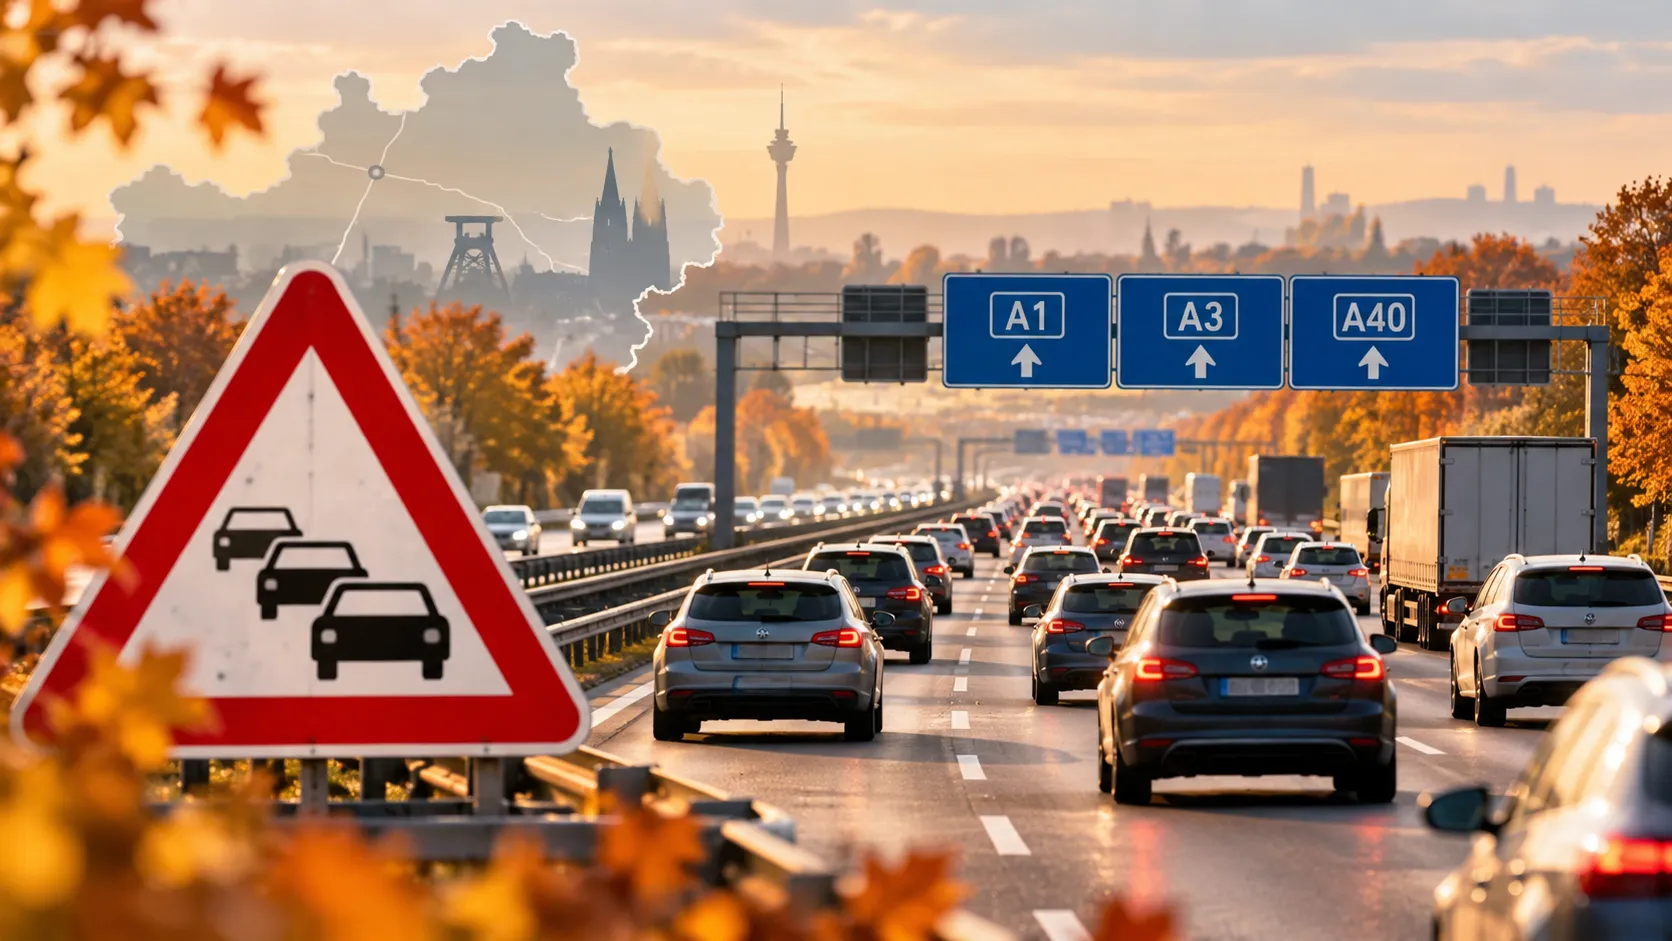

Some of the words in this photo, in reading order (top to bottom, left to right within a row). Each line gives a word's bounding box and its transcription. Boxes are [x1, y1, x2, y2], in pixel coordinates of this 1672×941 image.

[1005, 301, 1045, 330] A1
[1178, 302, 1223, 331] A3
[1342, 302, 1406, 332] A40
